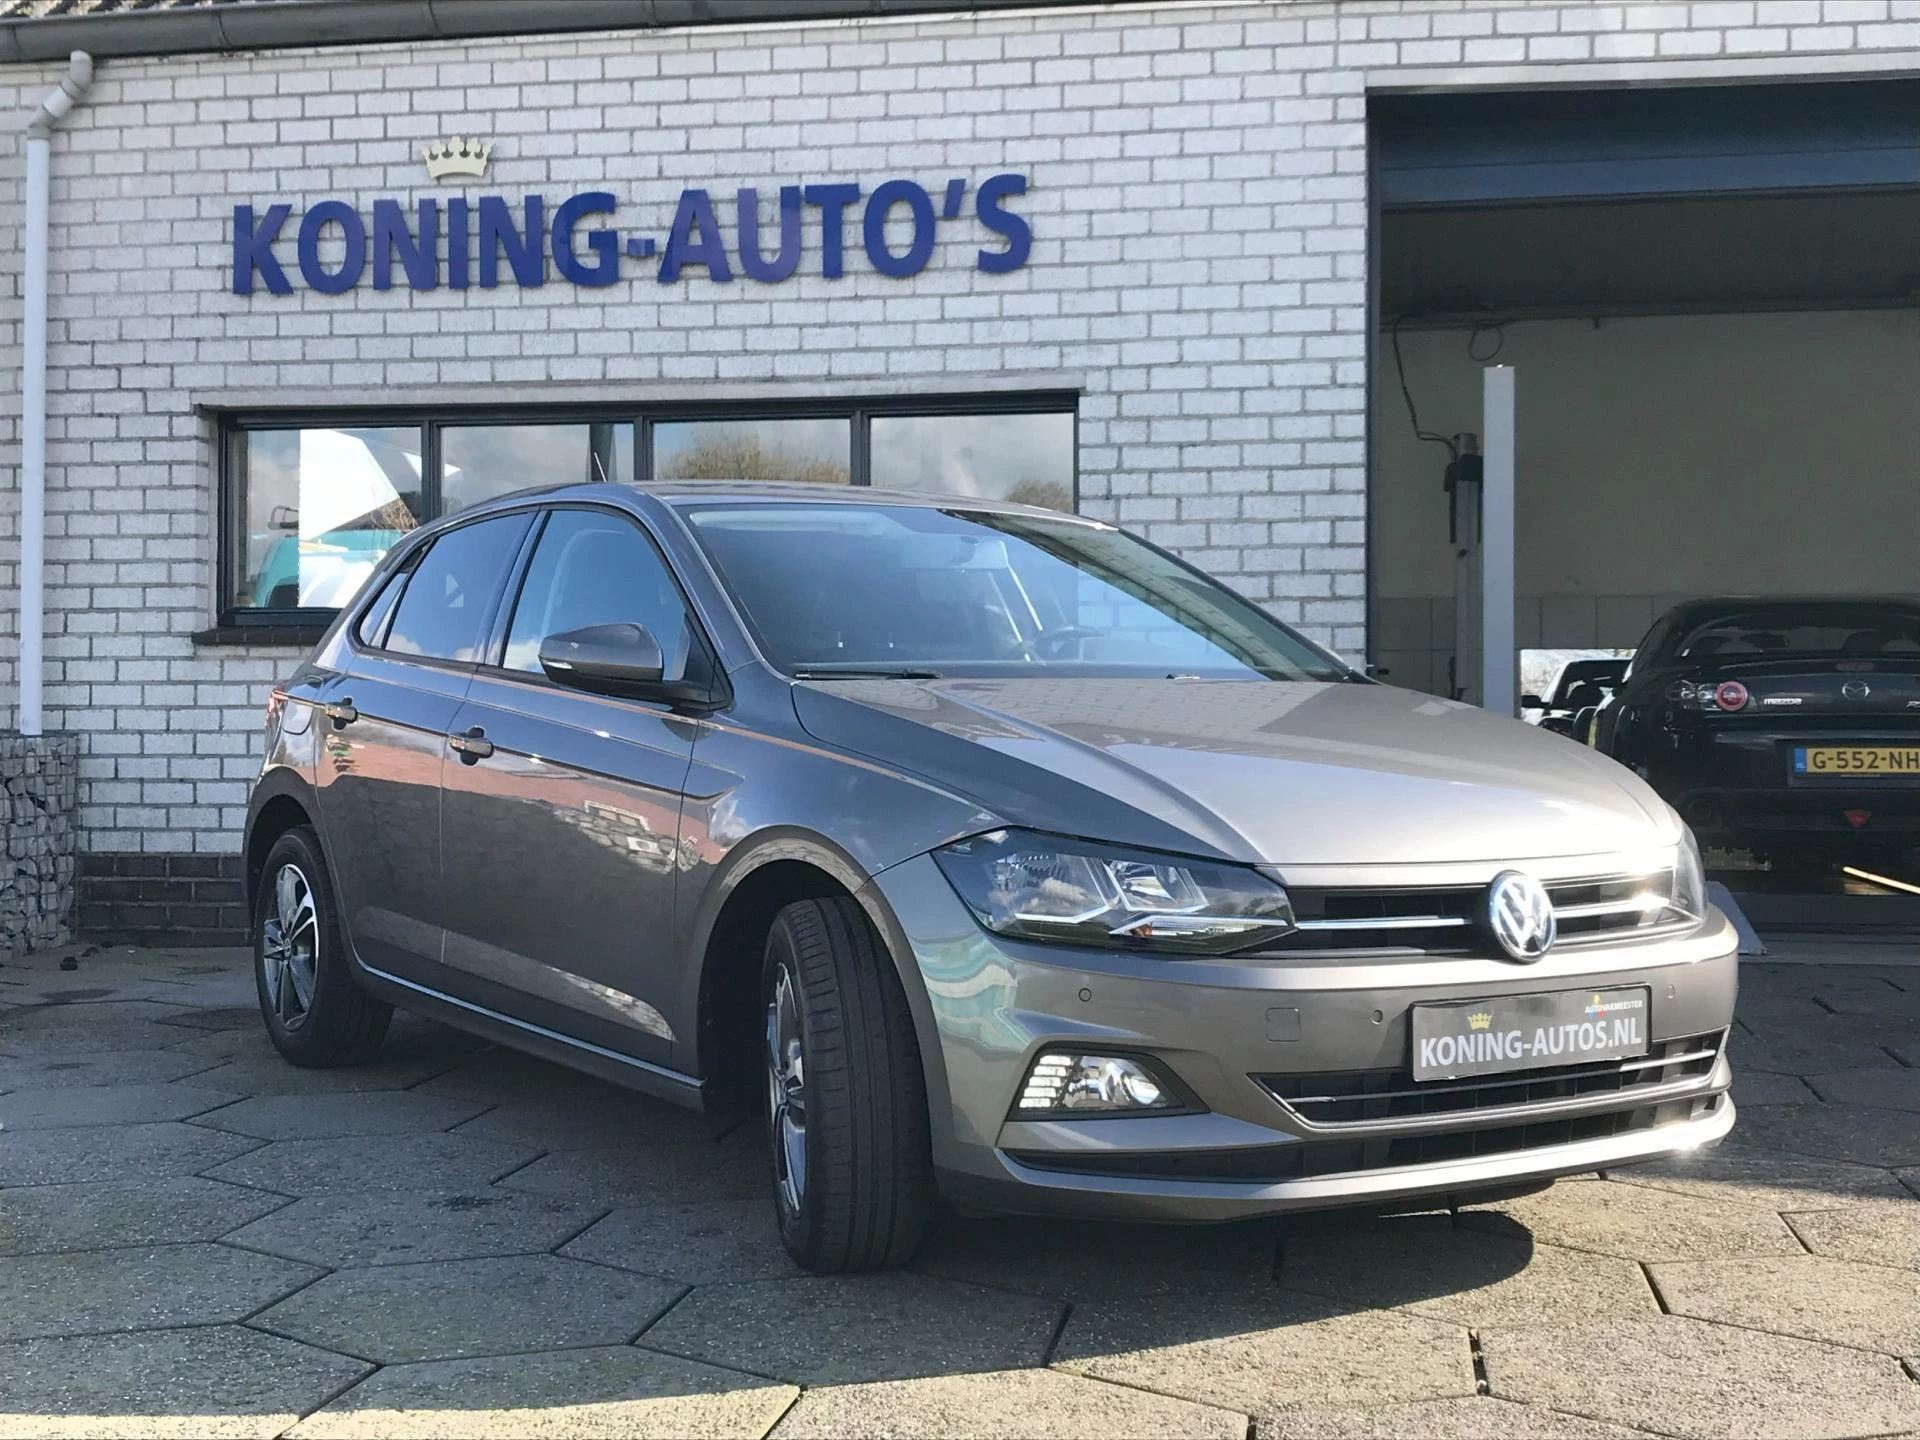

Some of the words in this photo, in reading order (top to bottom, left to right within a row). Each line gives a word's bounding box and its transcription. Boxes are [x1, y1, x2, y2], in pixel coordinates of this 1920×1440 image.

[232, 173, 1035, 296] KONING-AUTO'S
[1812, 751, 1919, 769] G-552-NH
[1420, 1017, 1642, 1067] KONING-AUTOS.NL
